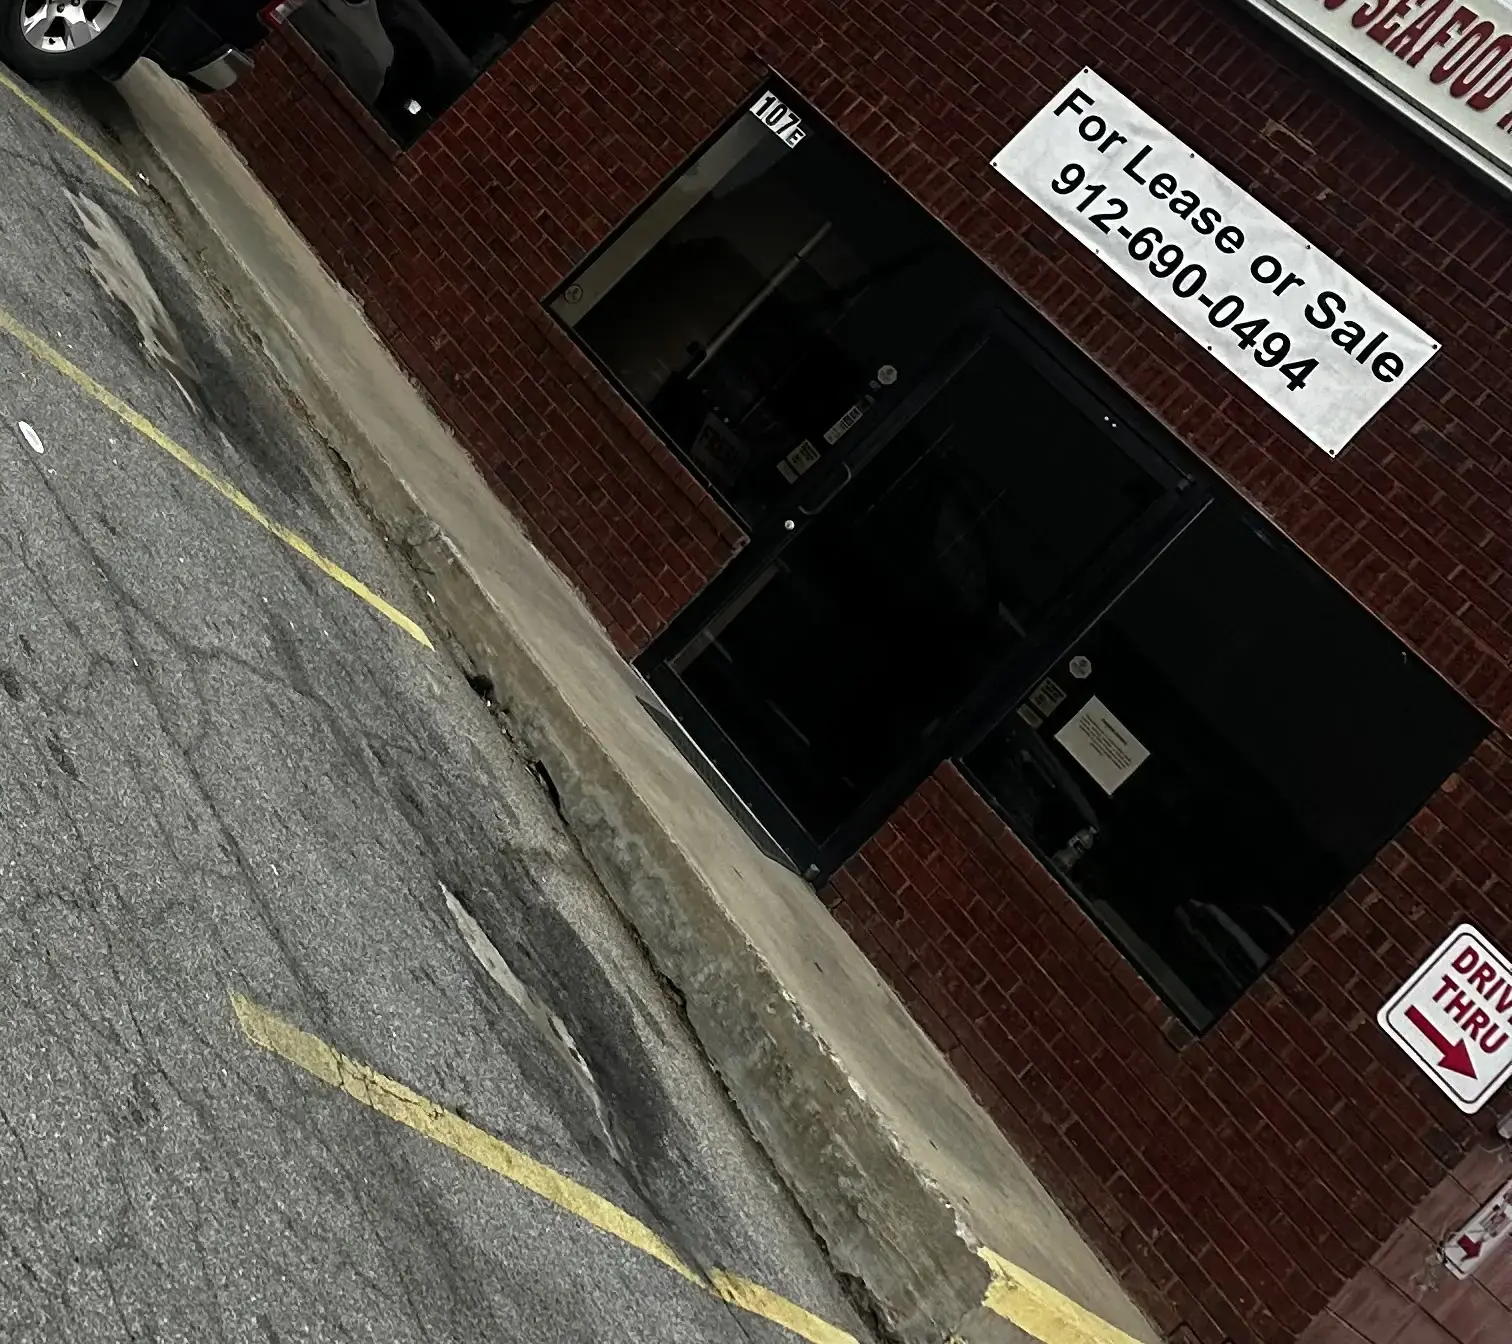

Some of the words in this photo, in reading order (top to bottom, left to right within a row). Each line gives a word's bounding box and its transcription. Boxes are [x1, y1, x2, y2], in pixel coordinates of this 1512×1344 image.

[1051, 163, 1320, 392] 912-690-0494
[1053, 88, 1127, 153] For
[1122, 145, 1245, 254] Lease
[1250, 254, 1305, 297] or
[1304, 291, 1404, 383] Sale
[1432, 974, 1509, 1054] THRU
[1451, 945, 1512, 1026] DRIV
